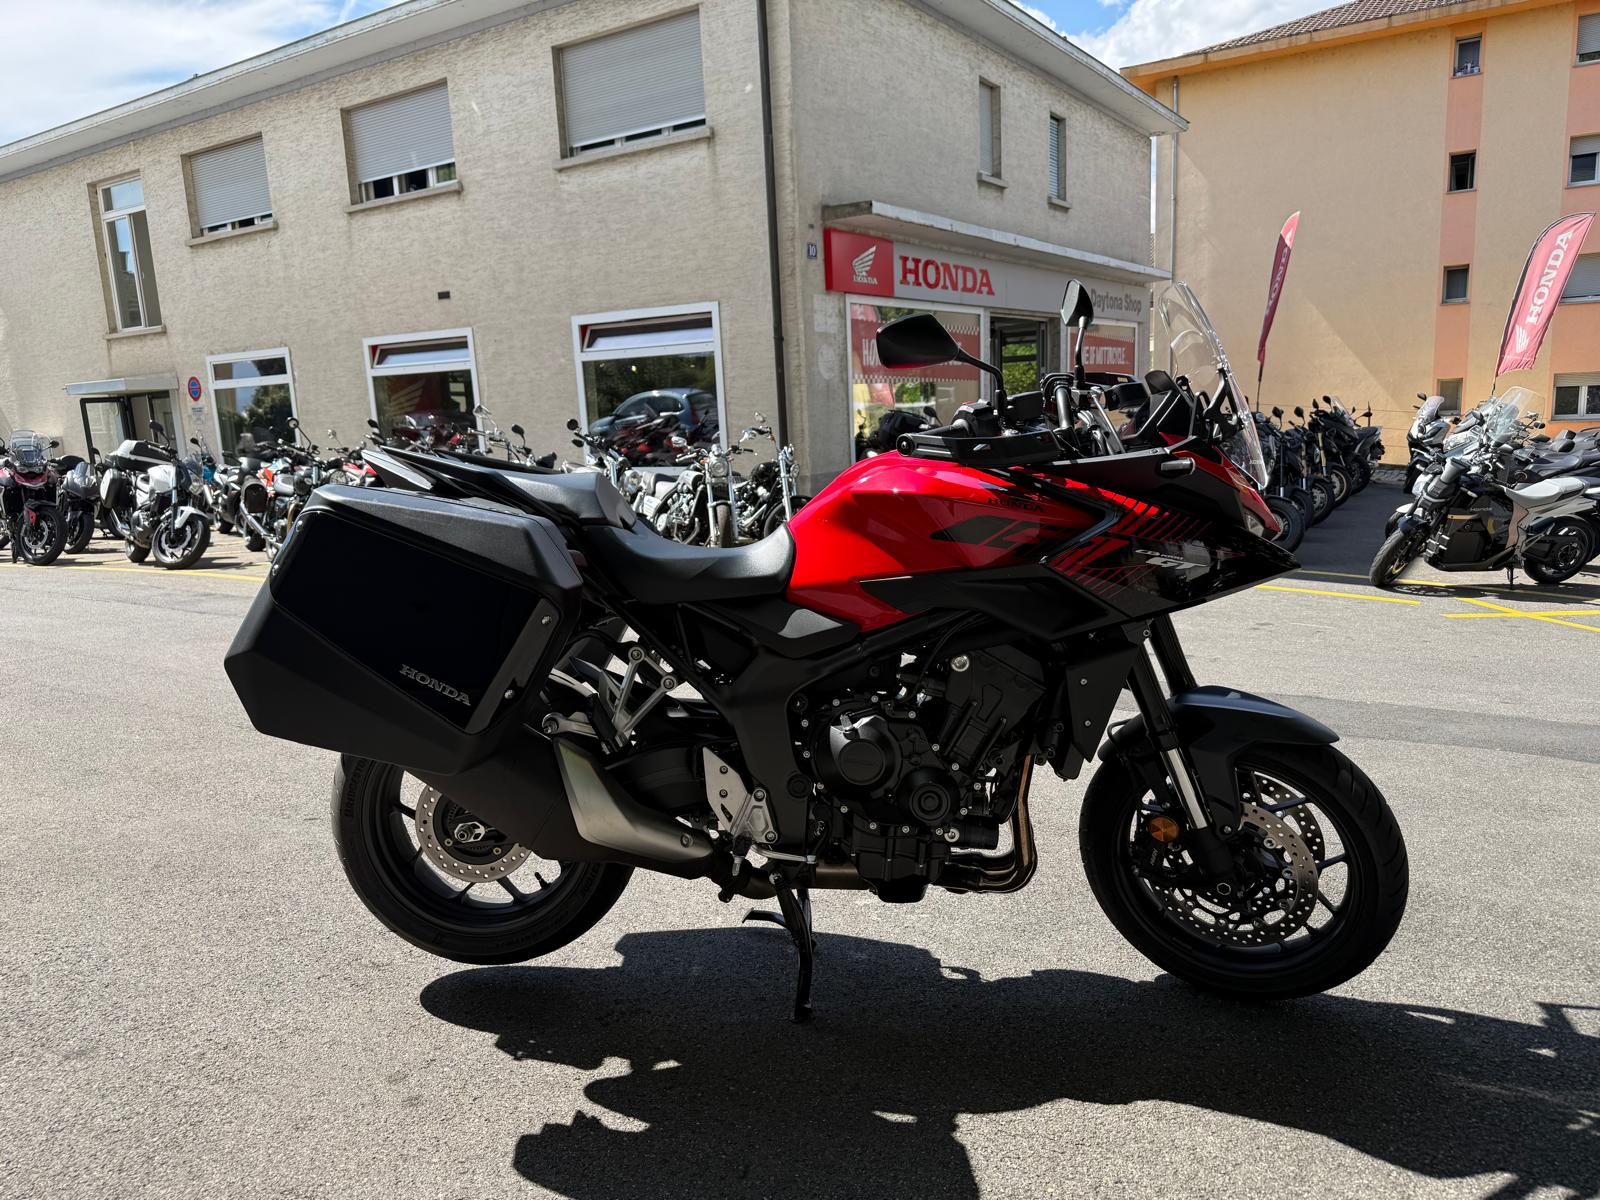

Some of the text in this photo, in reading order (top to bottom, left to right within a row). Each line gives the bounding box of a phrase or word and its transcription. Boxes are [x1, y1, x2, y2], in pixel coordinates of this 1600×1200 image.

[808, 245, 816, 256] 10
[899, 255, 995, 296] HONDA
[1525, 229, 1574, 325] HONDA
[1090, 288, 1142, 316] Daytona Shop
[399, 664, 471, 706] HONDA
